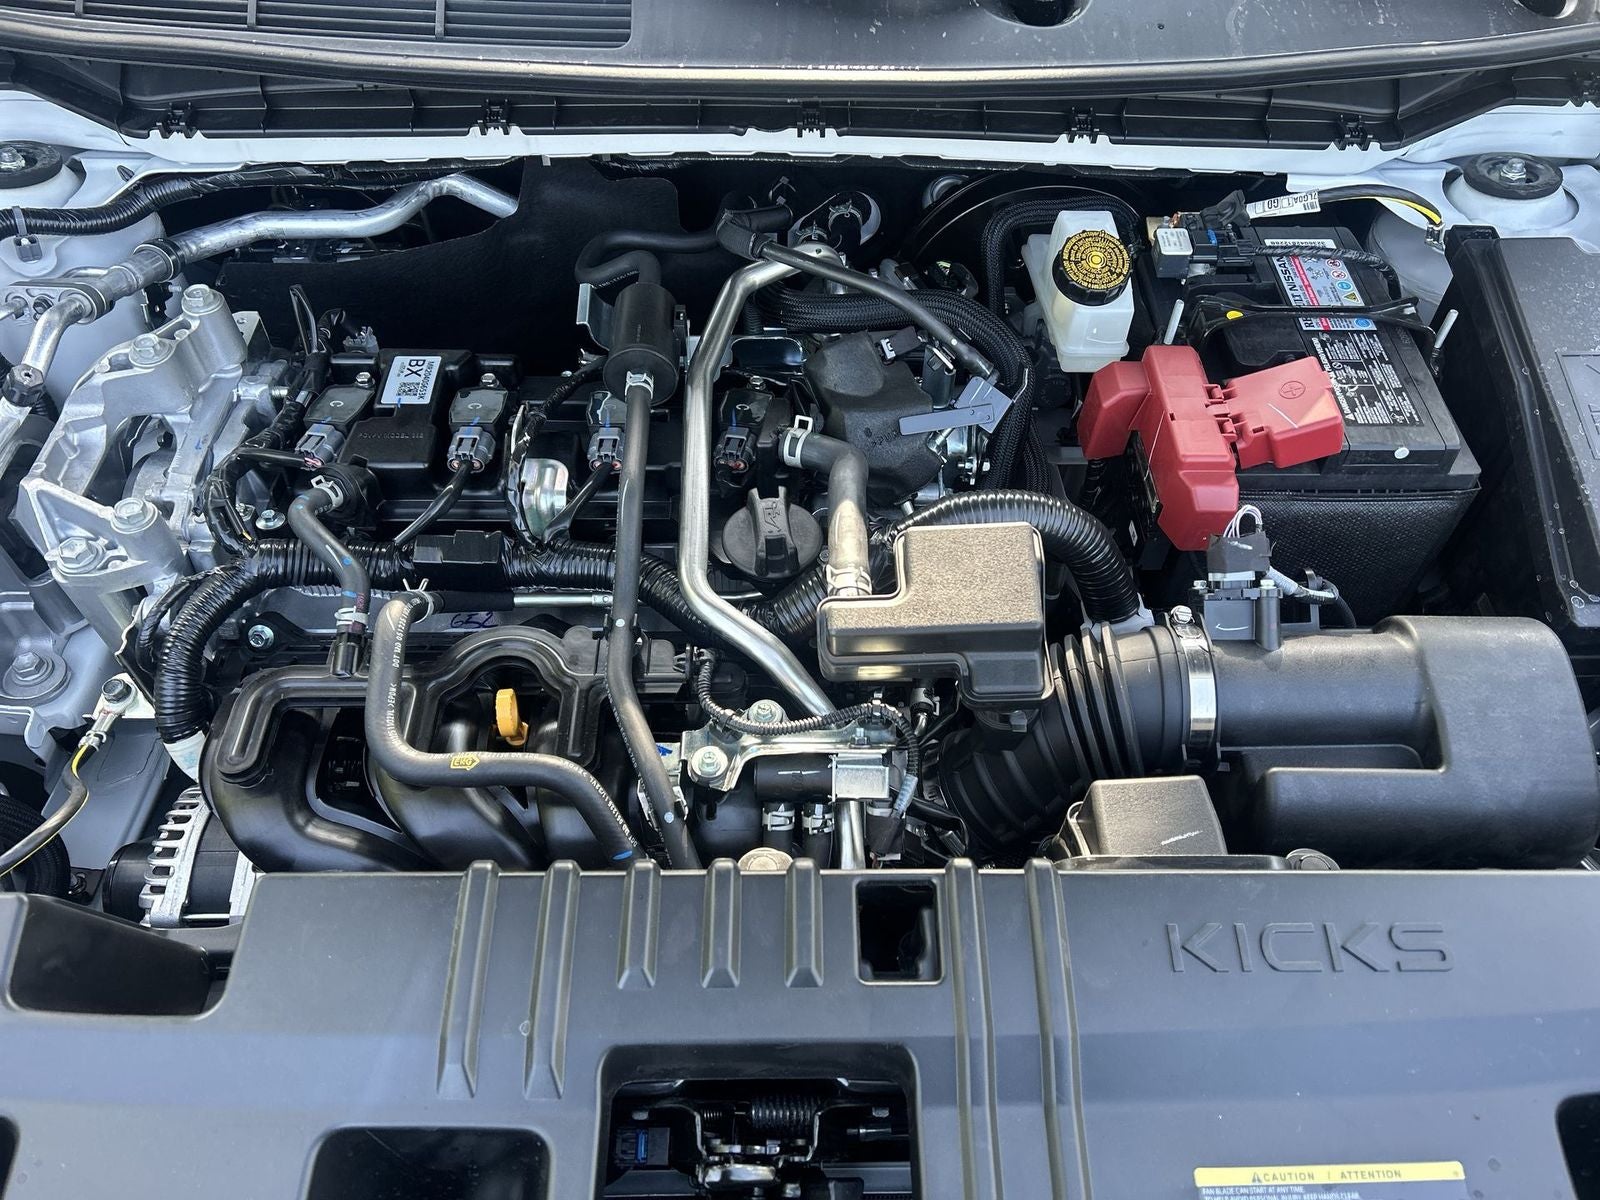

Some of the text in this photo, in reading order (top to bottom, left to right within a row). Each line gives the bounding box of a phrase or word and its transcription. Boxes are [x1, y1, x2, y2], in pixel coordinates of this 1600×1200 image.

[404, 359, 426, 377] BX
[1165, 921, 1456, 974] KICKS
[1263, 1172, 1315, 1182] CAUTION
[1340, 1169, 1402, 1180] ATTENTION
[1202, 1187, 1215, 1195] FAN
